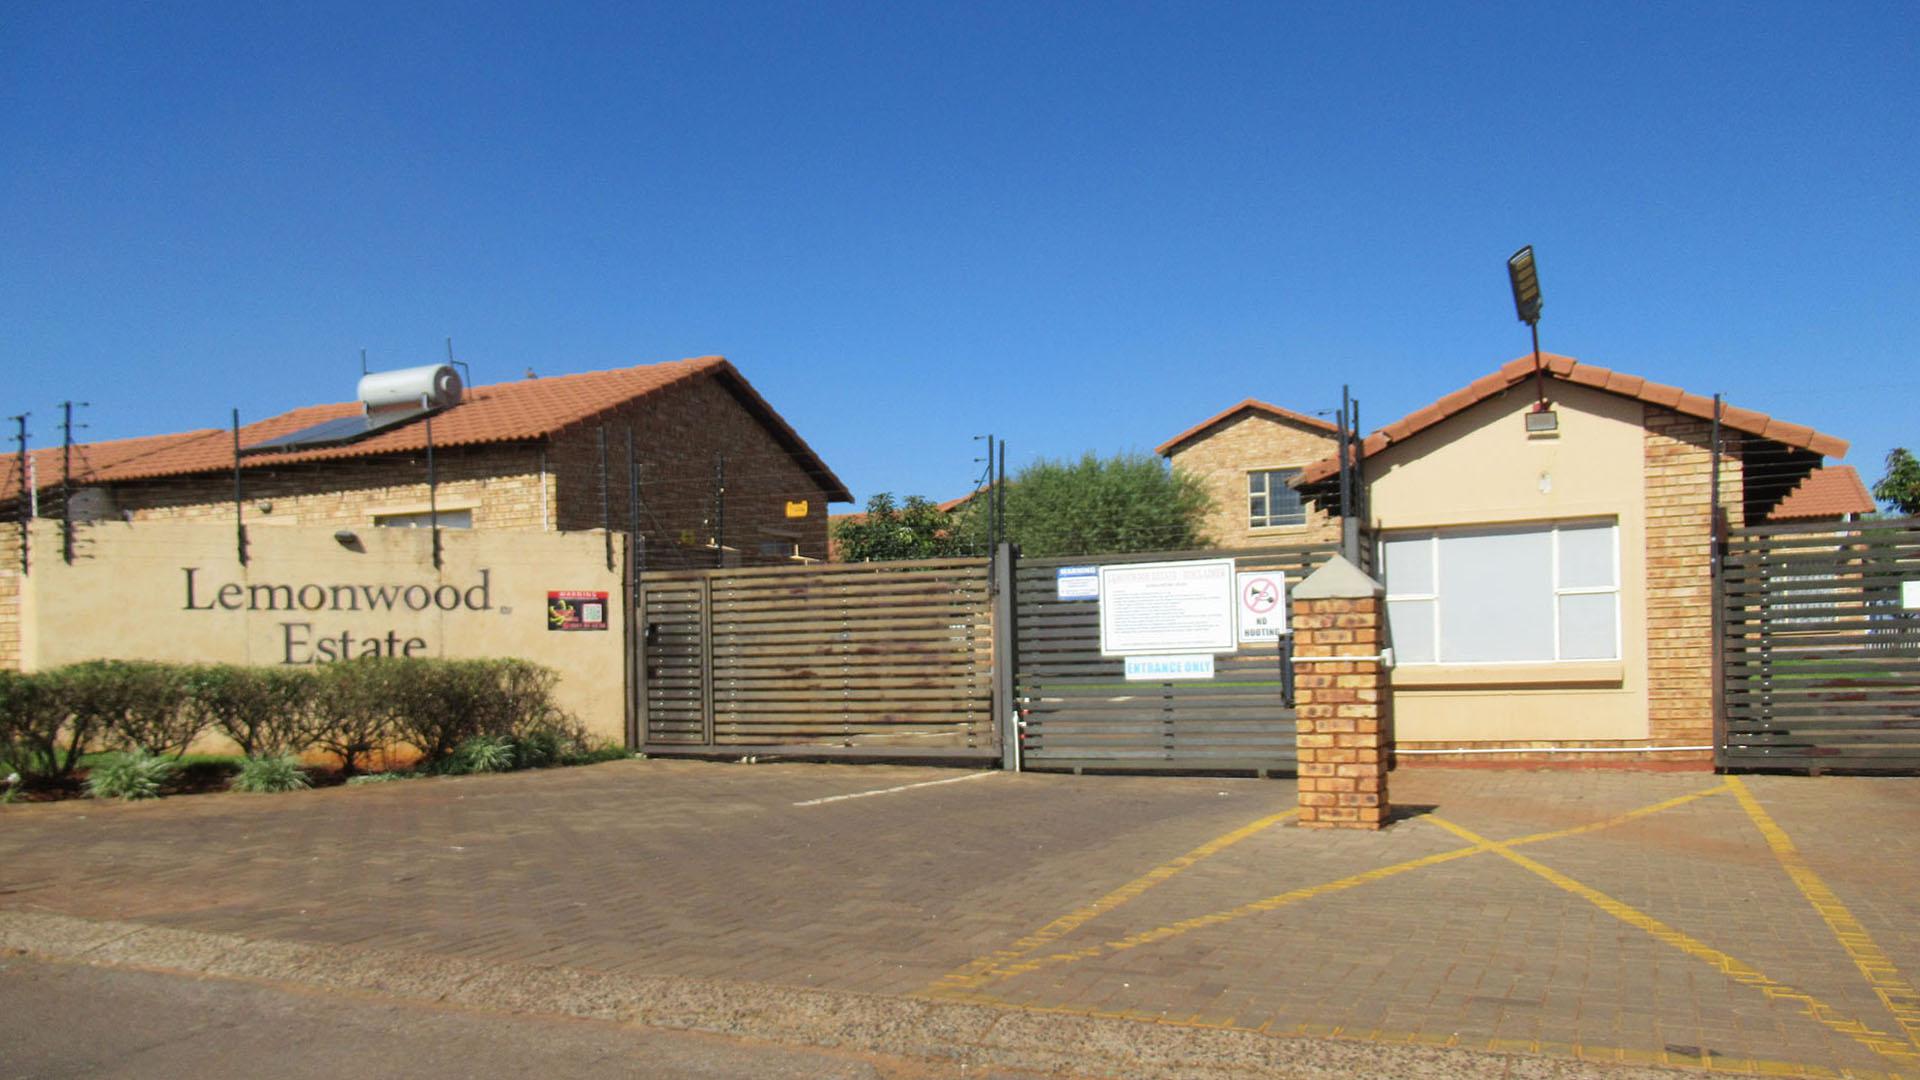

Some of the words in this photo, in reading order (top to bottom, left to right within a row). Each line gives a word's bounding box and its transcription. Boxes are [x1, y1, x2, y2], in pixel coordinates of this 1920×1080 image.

[181, 567, 494, 611] Lemonwood
[1256, 616, 1267, 625] NO
[1244, 628, 1281, 637] HOOTING
[280, 622, 428, 665] Estate
[1127, 662, 1182, 674] ENTRANCE
[1184, 661, 1211, 673] ONLY
